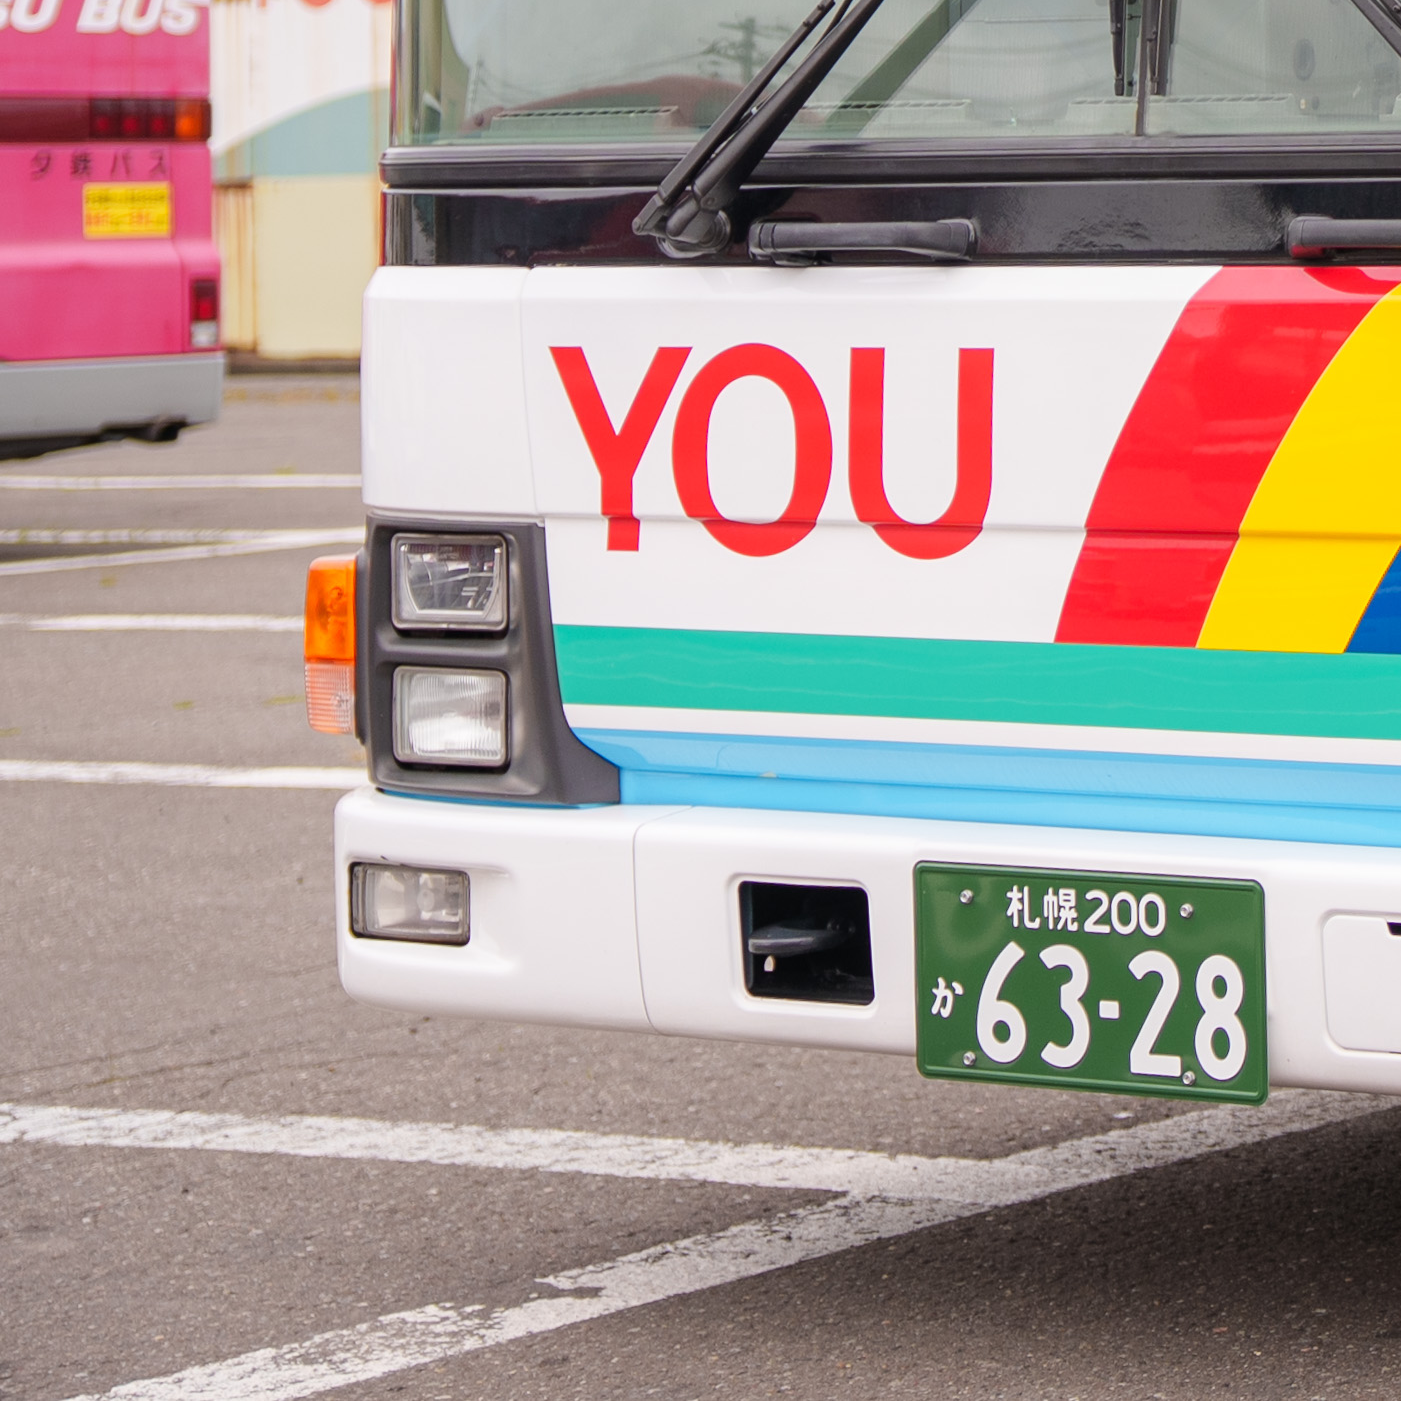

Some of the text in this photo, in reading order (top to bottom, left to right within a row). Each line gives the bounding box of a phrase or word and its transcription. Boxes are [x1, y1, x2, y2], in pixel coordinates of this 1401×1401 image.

[549, 342, 995, 560] YOU
[931, 940, 1248, 1082] か 63-28
